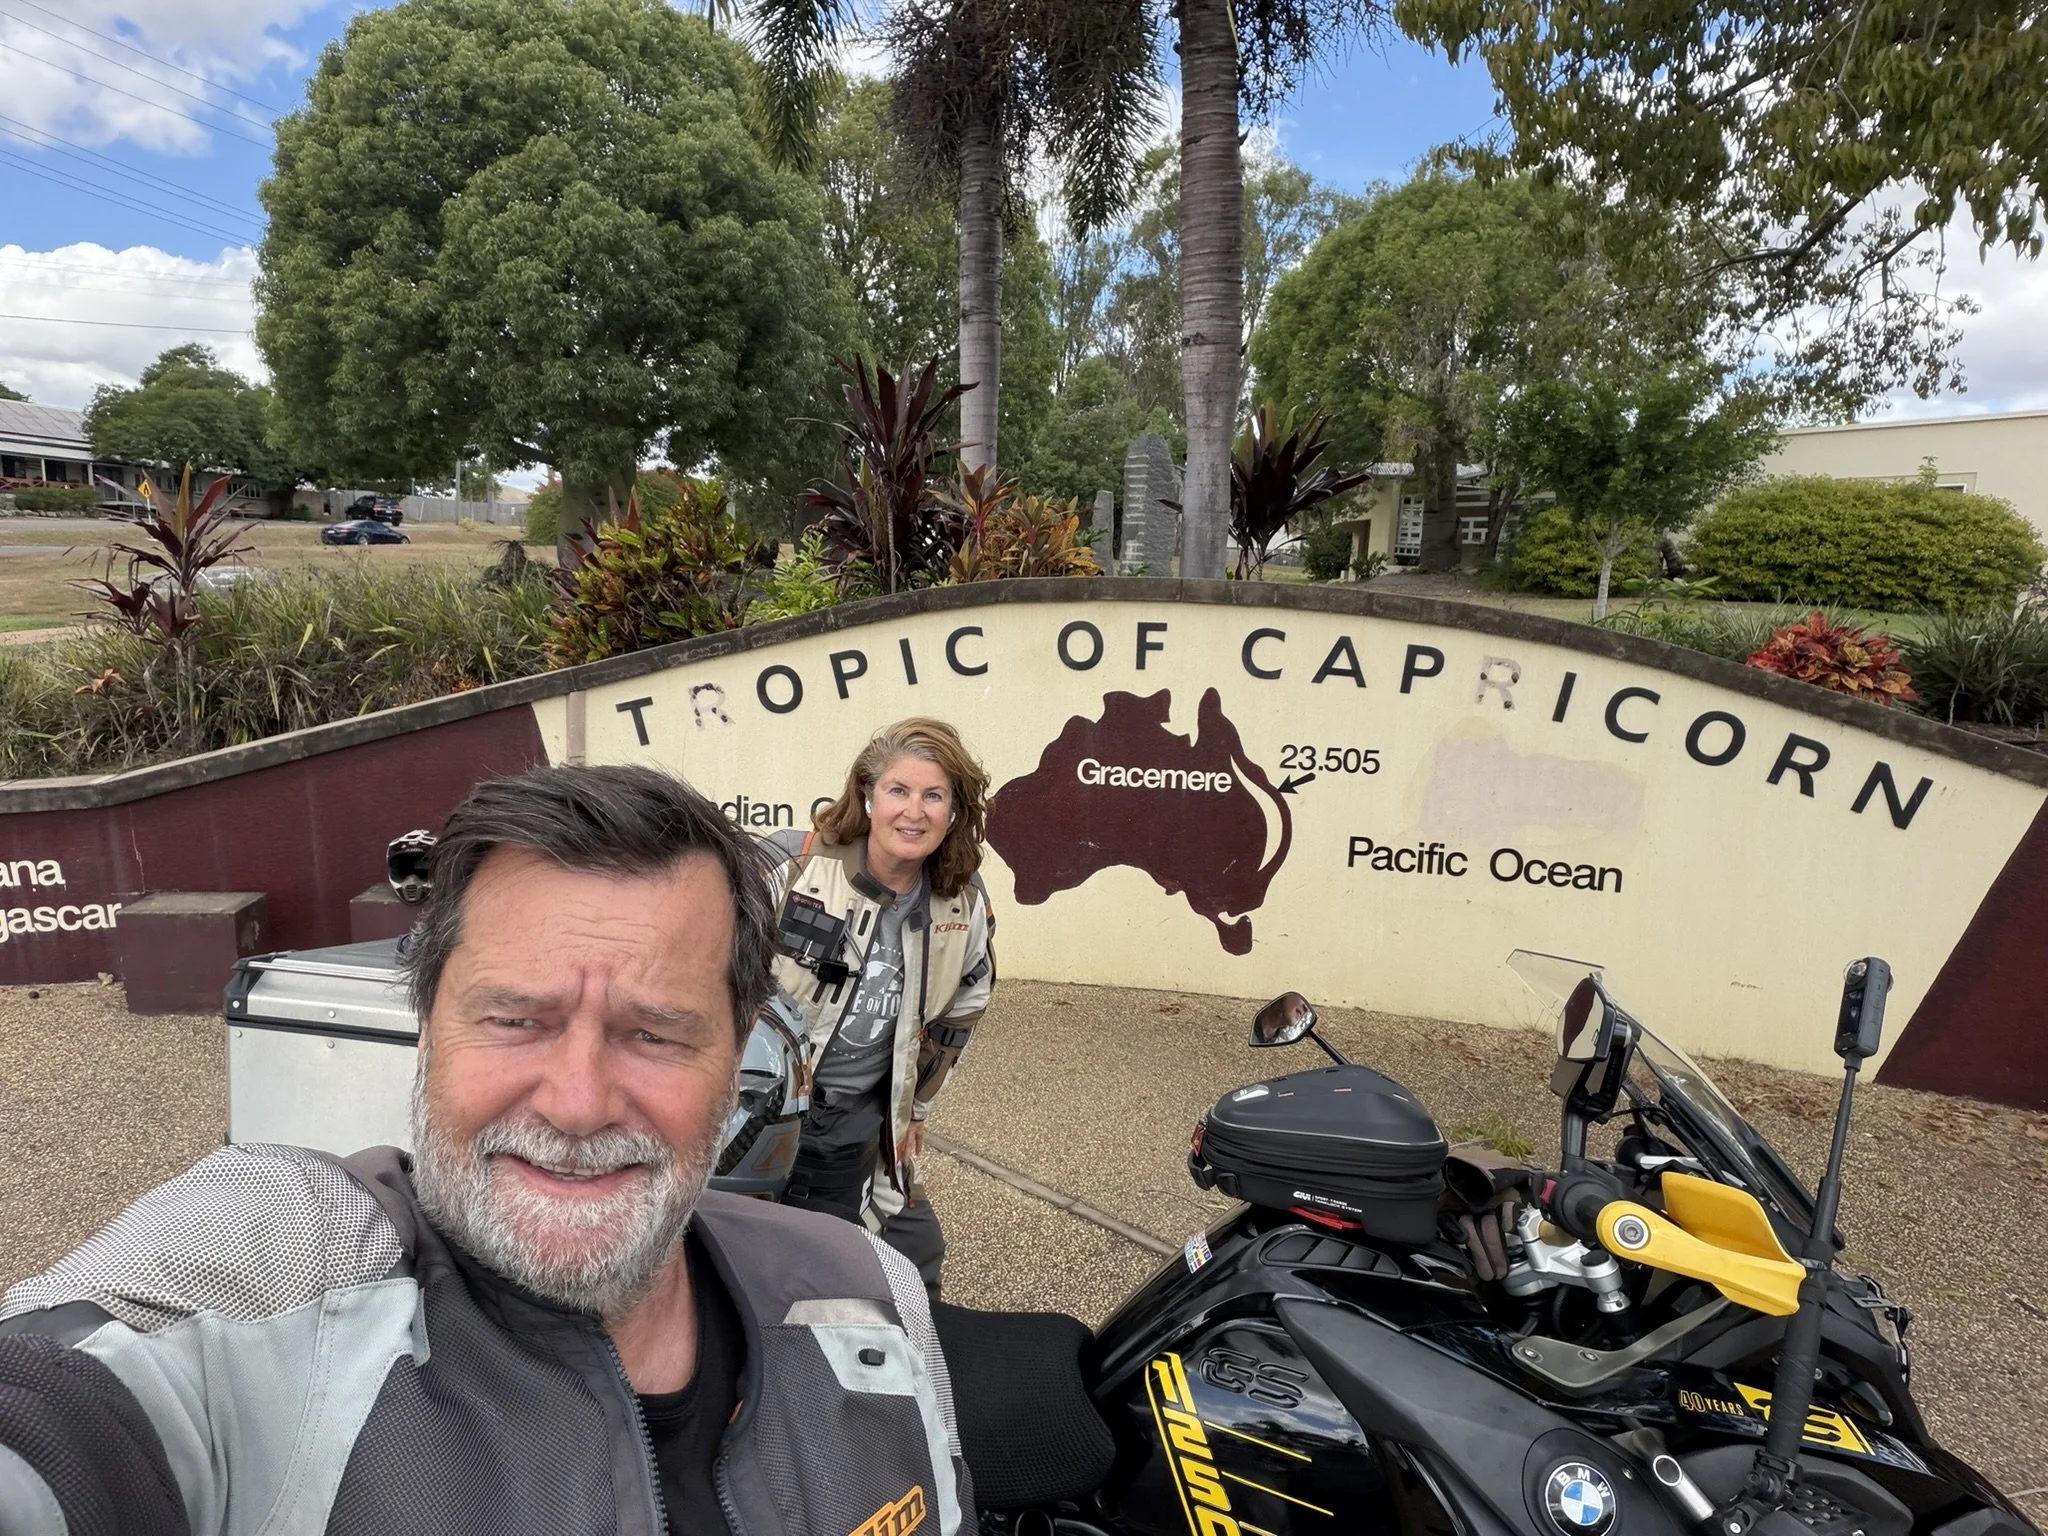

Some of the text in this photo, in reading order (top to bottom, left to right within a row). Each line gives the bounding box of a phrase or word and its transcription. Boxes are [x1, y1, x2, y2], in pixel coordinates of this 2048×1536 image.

[615, 620, 1935, 831] TROPIC OF CAPRICORN
[1076, 757, 1233, 793] Gracemere
[1279, 744, 1381, 775] 23.505
[718, 794, 794, 827] dian
[1347, 836, 1624, 893] Pacific Ocean
[1293, 1191, 1311, 1201] GIVI
[1679, 1389, 1745, 1417] 40 YEARS
[1555, 1467, 1611, 1498] BMW
